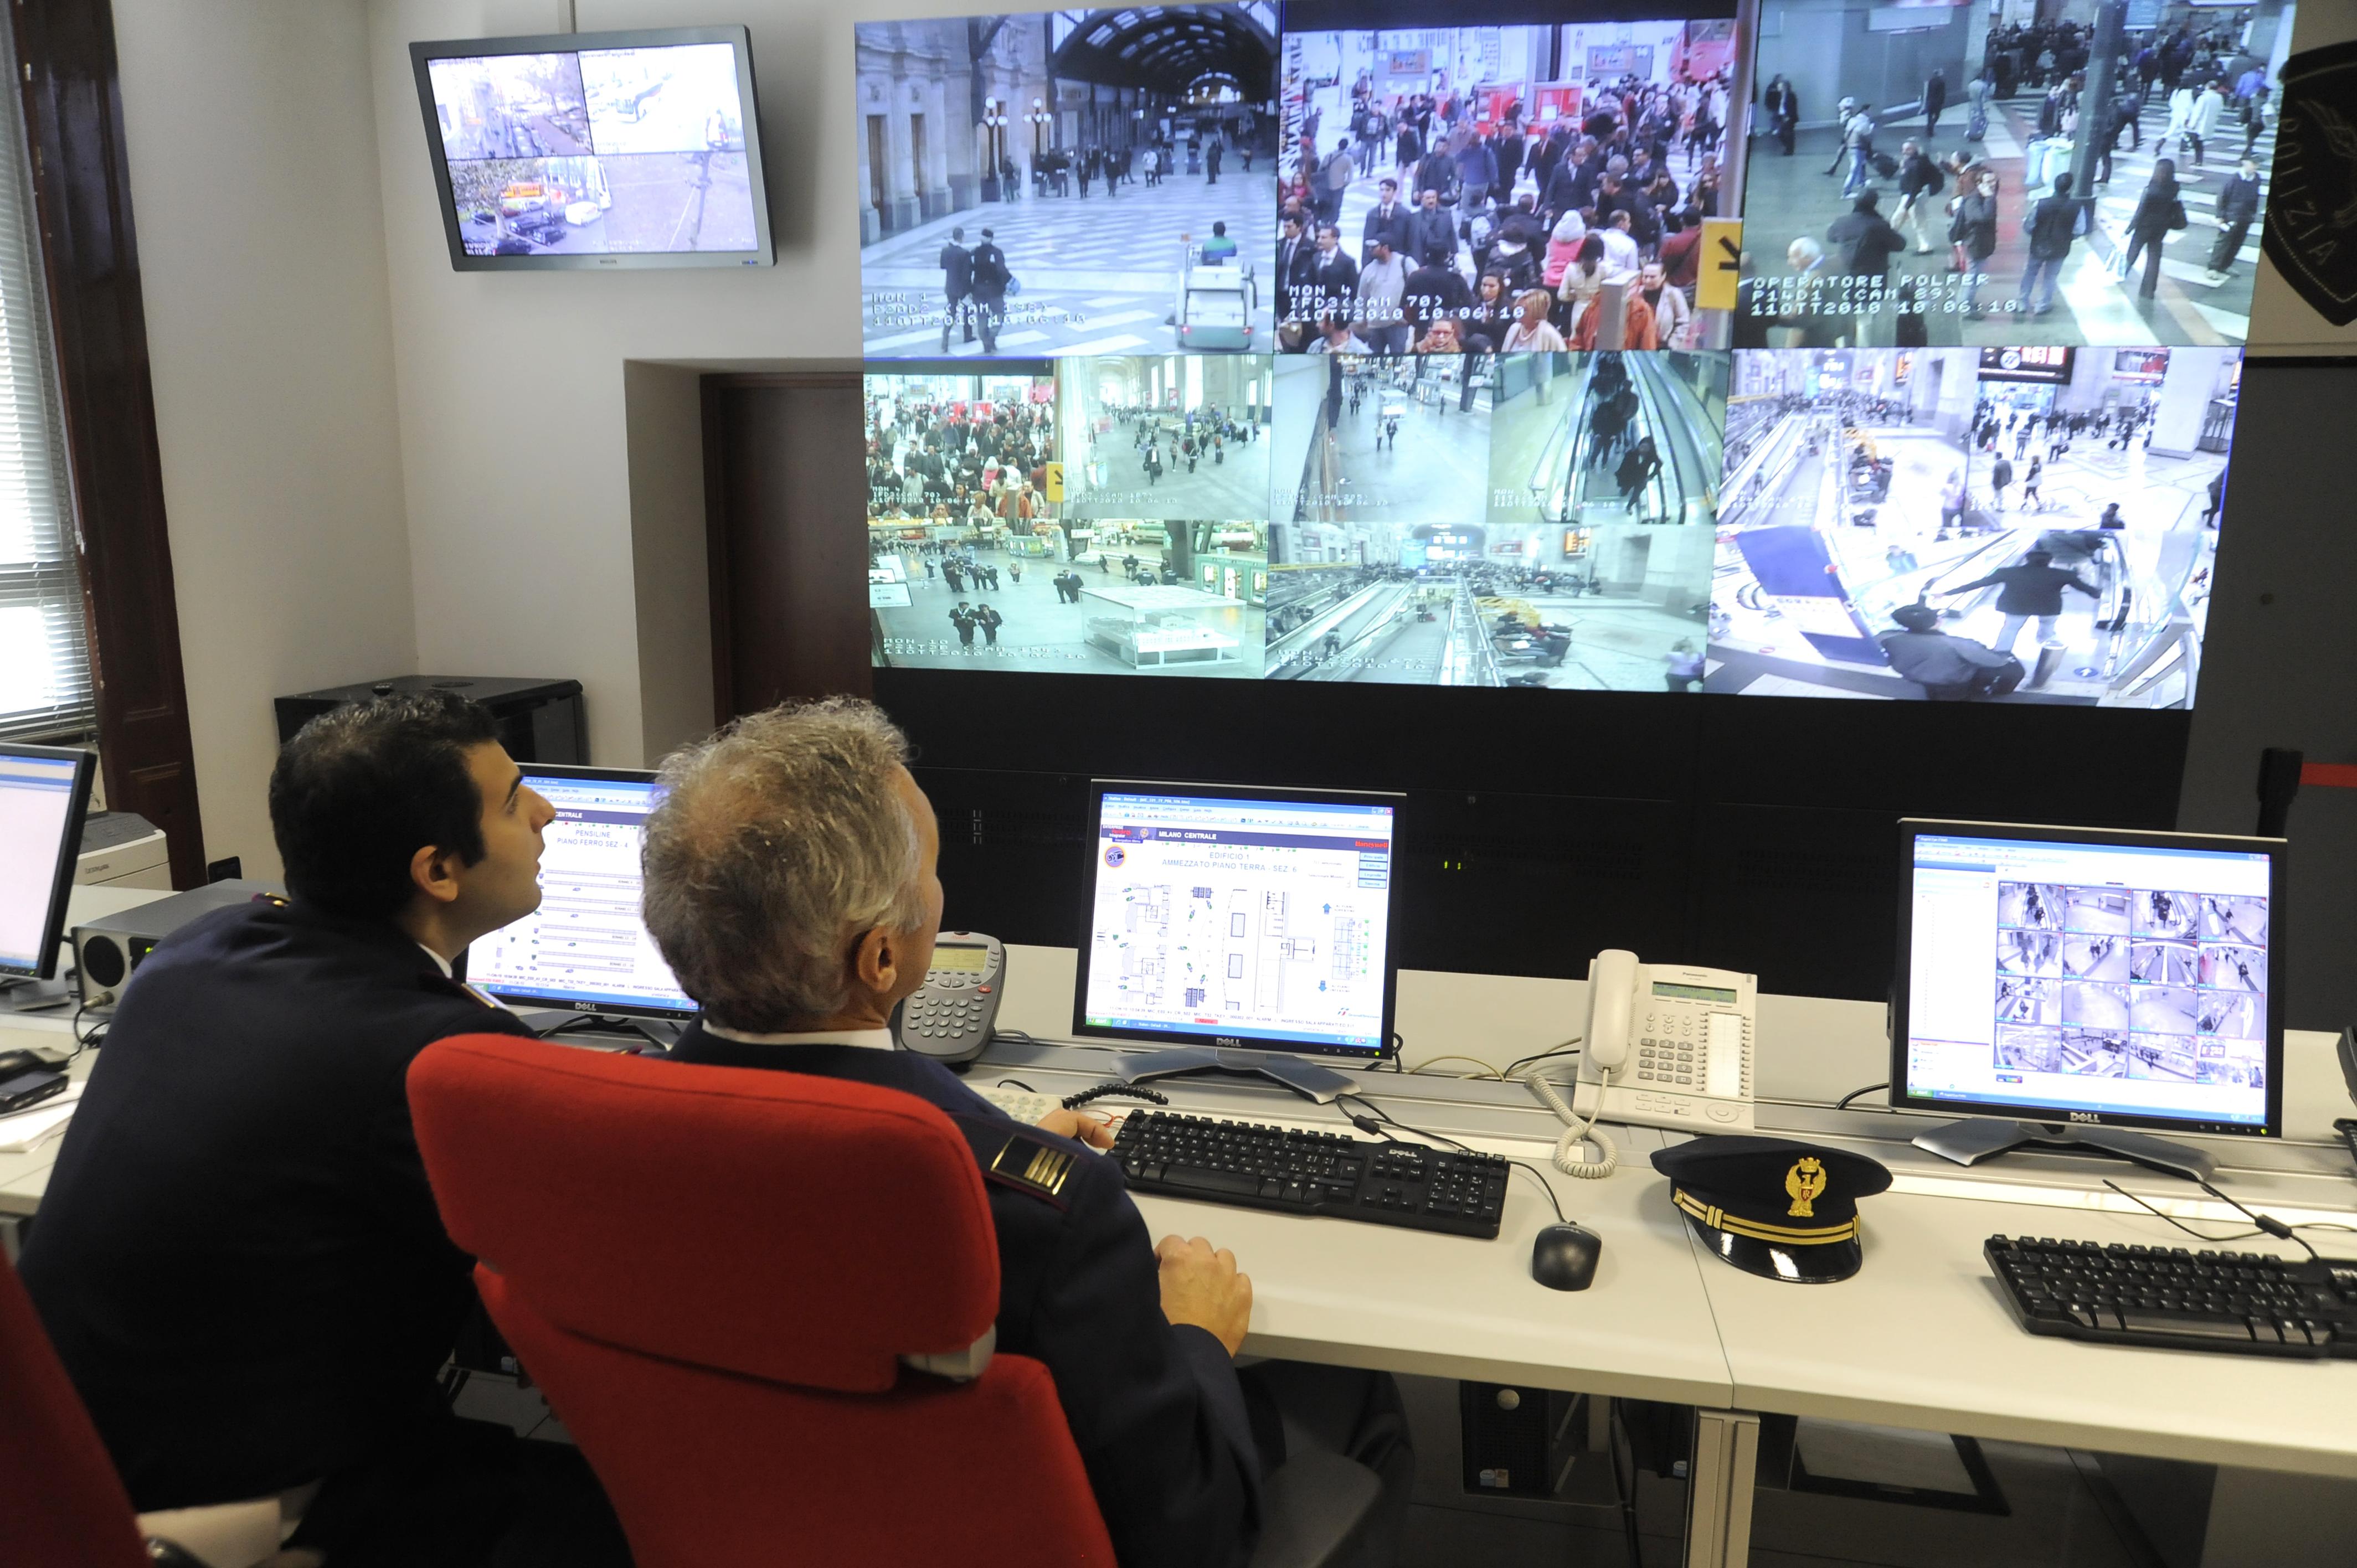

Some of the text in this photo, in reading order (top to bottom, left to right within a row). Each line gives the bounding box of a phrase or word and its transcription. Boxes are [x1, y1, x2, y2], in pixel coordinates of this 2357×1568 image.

[1752, 274, 1989, 290] OPERATORE POLFER
[1289, 283, 1351, 297] MON 4
[1752, 288, 1822, 302] P14D1
[1841, 287, 1897, 302] (CAM
[871, 292, 929, 303] MON 1
[1897, 300, 2018, 314] 10:06:10
[1418, 306, 1525, 321] 10:06:10
[1184, 832, 1217, 840] CENTRALE
[1210, 852, 1244, 860] EDIFICIO
[1162, 859, 1210, 868] AMMEZZATO
[1212, 861, 1237, 869] PIANO
[1239, 863, 1266, 871] TERRA
[575, 1002, 596, 1011] DELL
[1216, 1038, 1242, 1047] DELL
[2070, 1112, 2101, 1123] DELL
[1389, 1149, 1417, 1158] DELL
